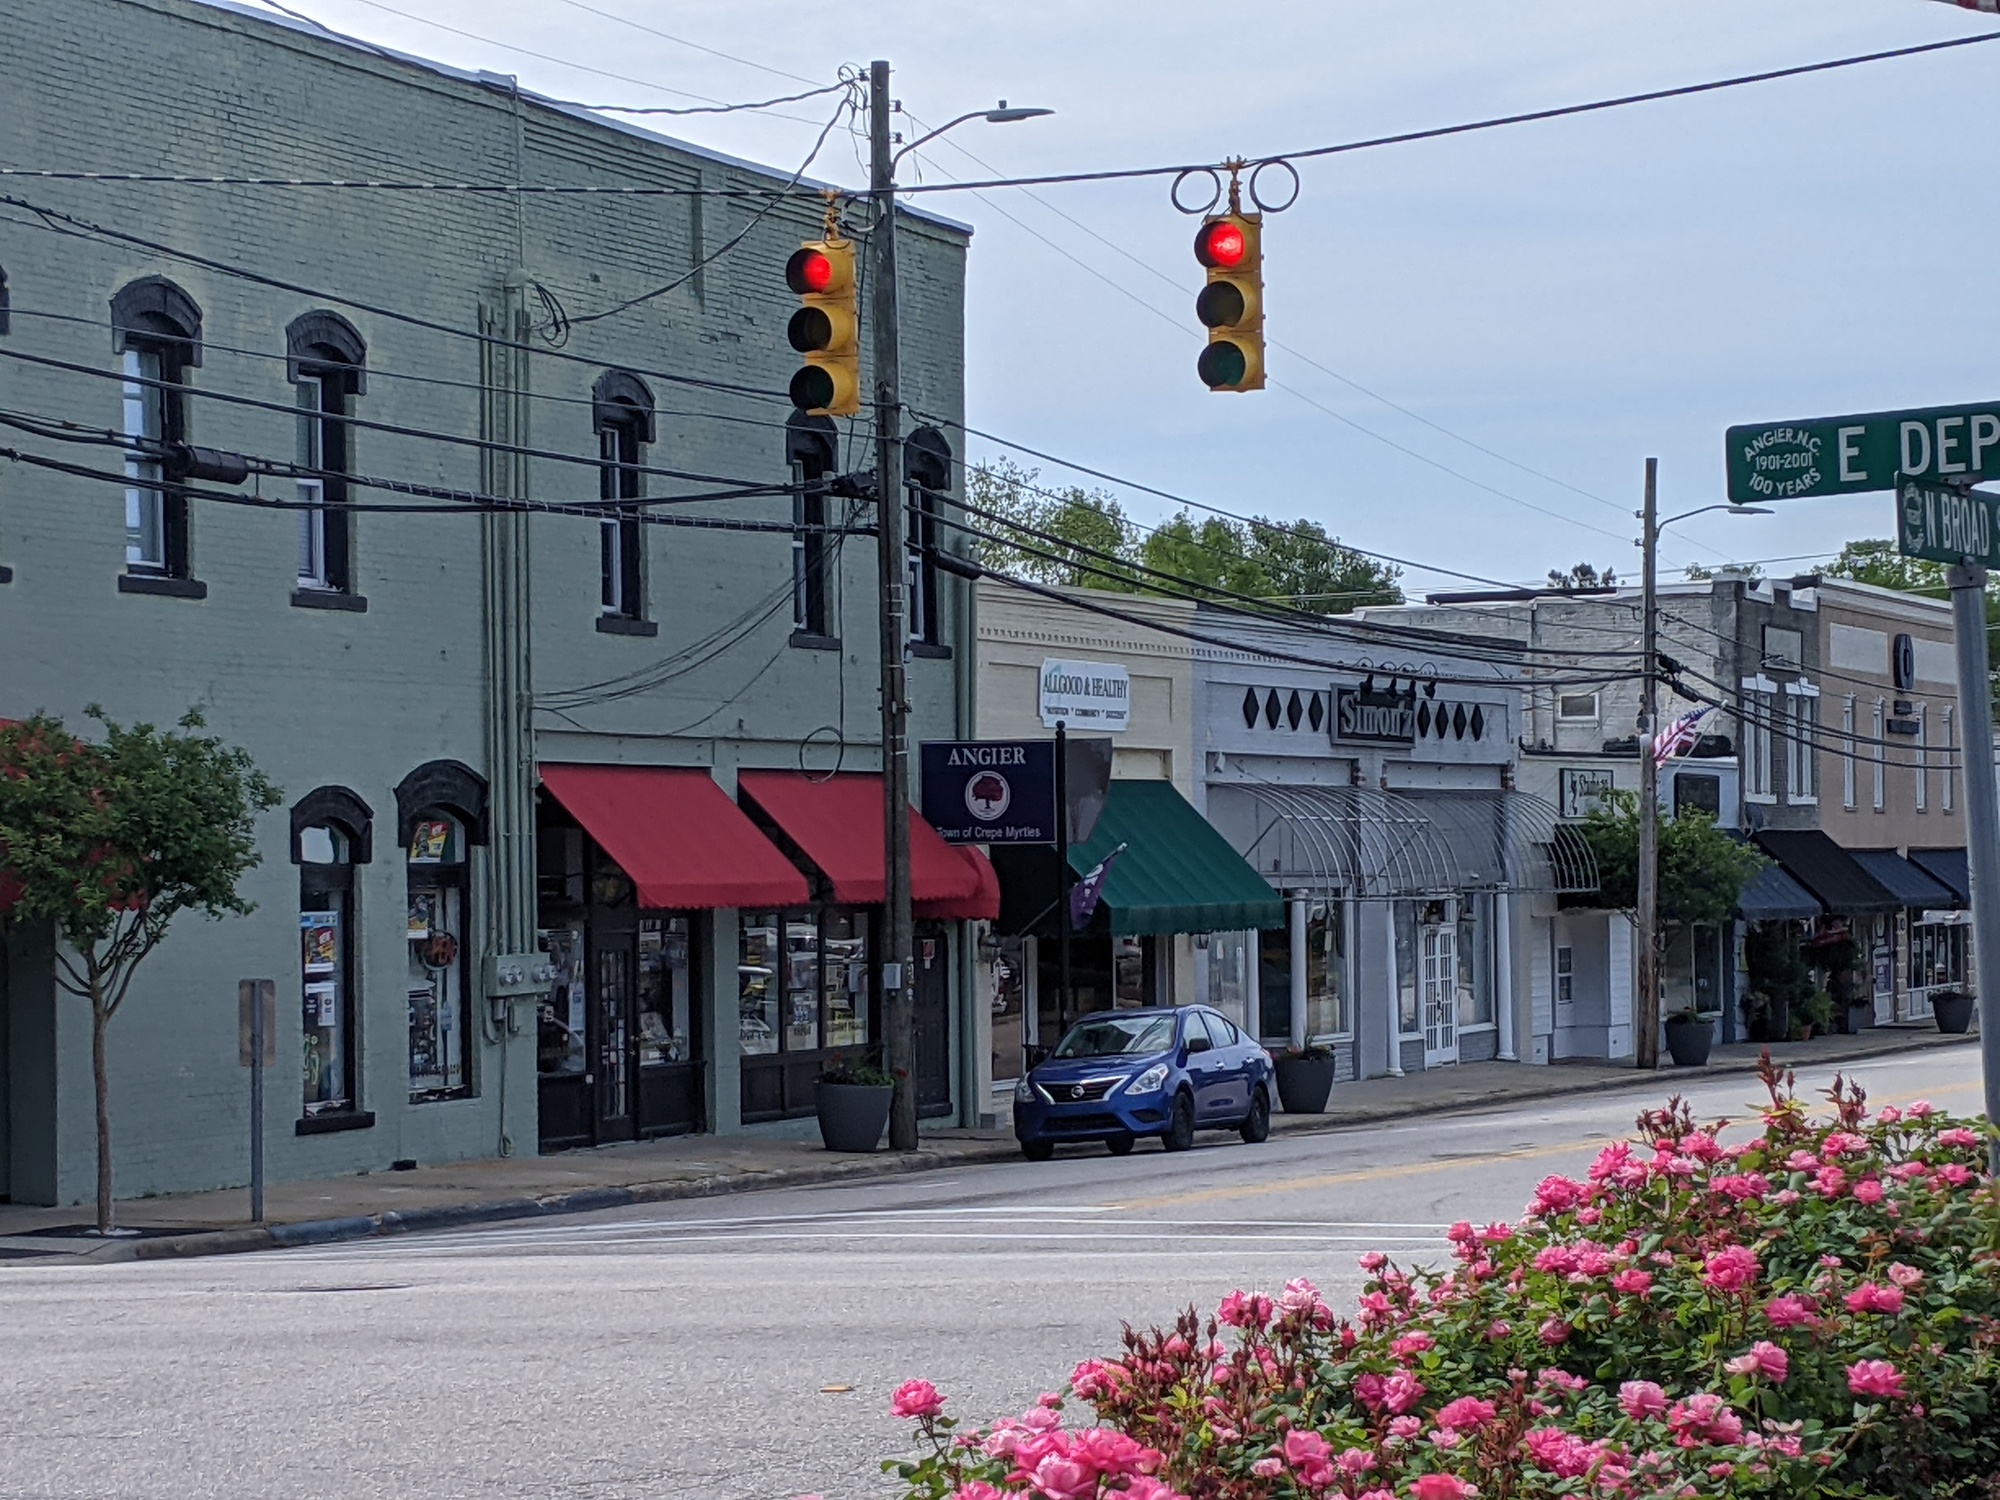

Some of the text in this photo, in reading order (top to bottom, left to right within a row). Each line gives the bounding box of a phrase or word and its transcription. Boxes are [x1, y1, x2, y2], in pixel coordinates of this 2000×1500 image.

[1755, 451, 1813, 471] 1901-2001
[1838, 414, 2000, 482] E DEP
[1748, 467, 1822, 496] 100 YEARS
[1924, 490, 1937, 548] N
[1940, 492, 1990, 557] BROAD
[1043, 672, 1128, 698] ALLGOOD & HEALTHY
[947, 747, 1027, 766] ANGIER
[962, 827, 973, 838] of
[974, 827, 1003, 840] Crepe
[1005, 826, 1042, 840] Myrtles
